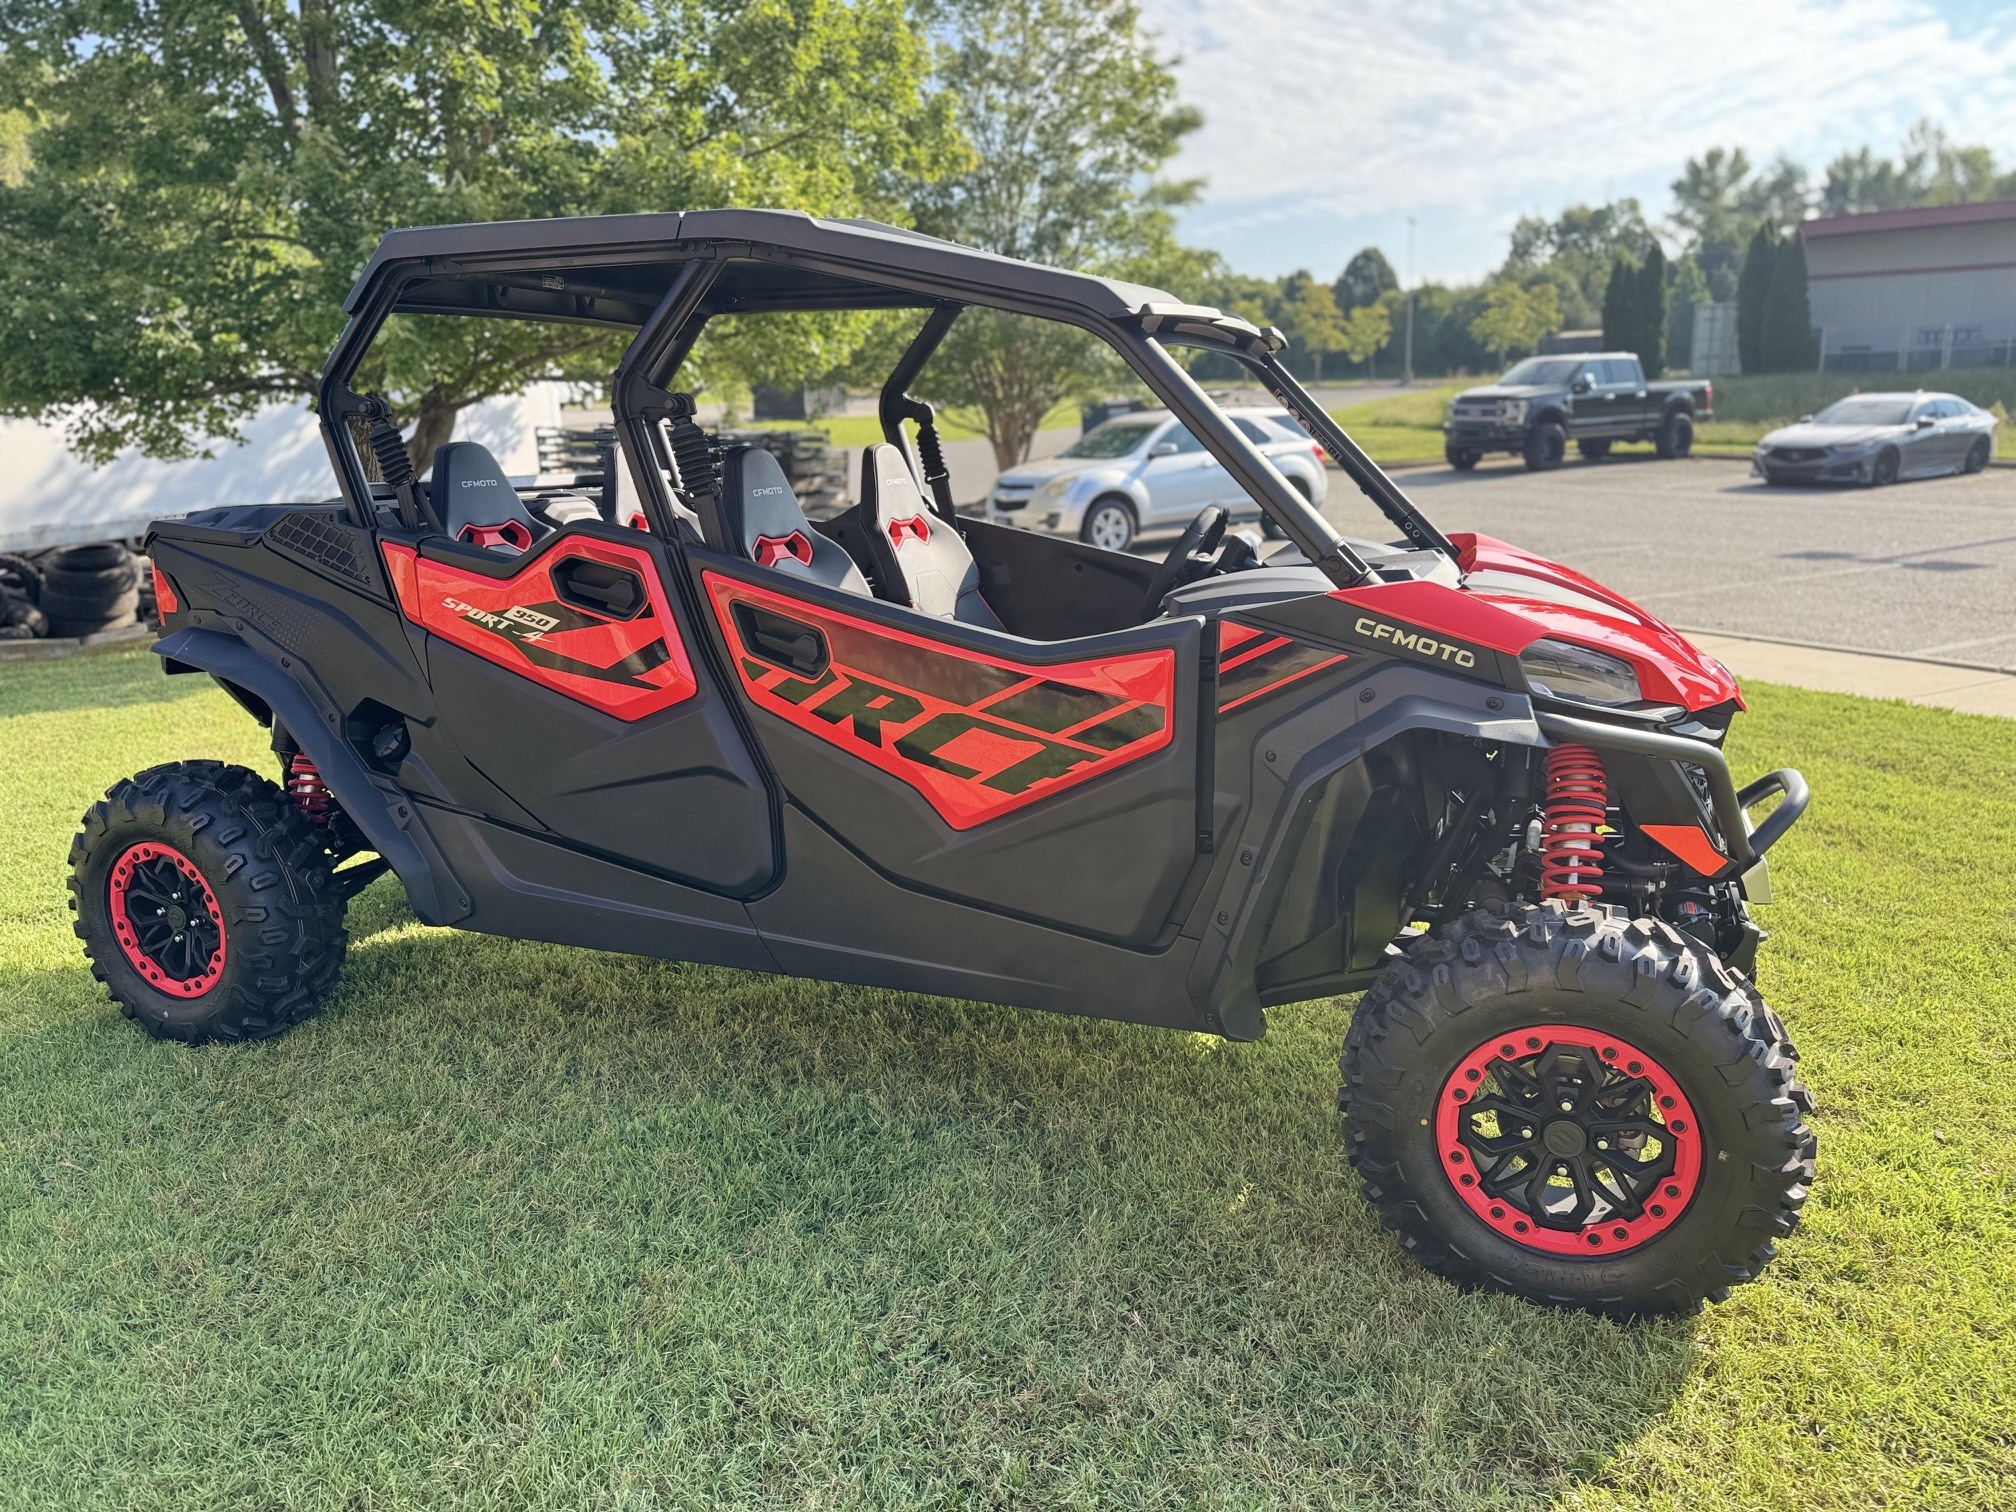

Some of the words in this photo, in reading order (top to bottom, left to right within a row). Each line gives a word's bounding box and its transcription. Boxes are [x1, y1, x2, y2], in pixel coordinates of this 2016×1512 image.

[461, 479, 498, 488] CFMOTO
[752, 486, 783, 497] CFMOTO
[512, 608, 551, 627] 950
[1354, 617, 1476, 668] CFMOTO
